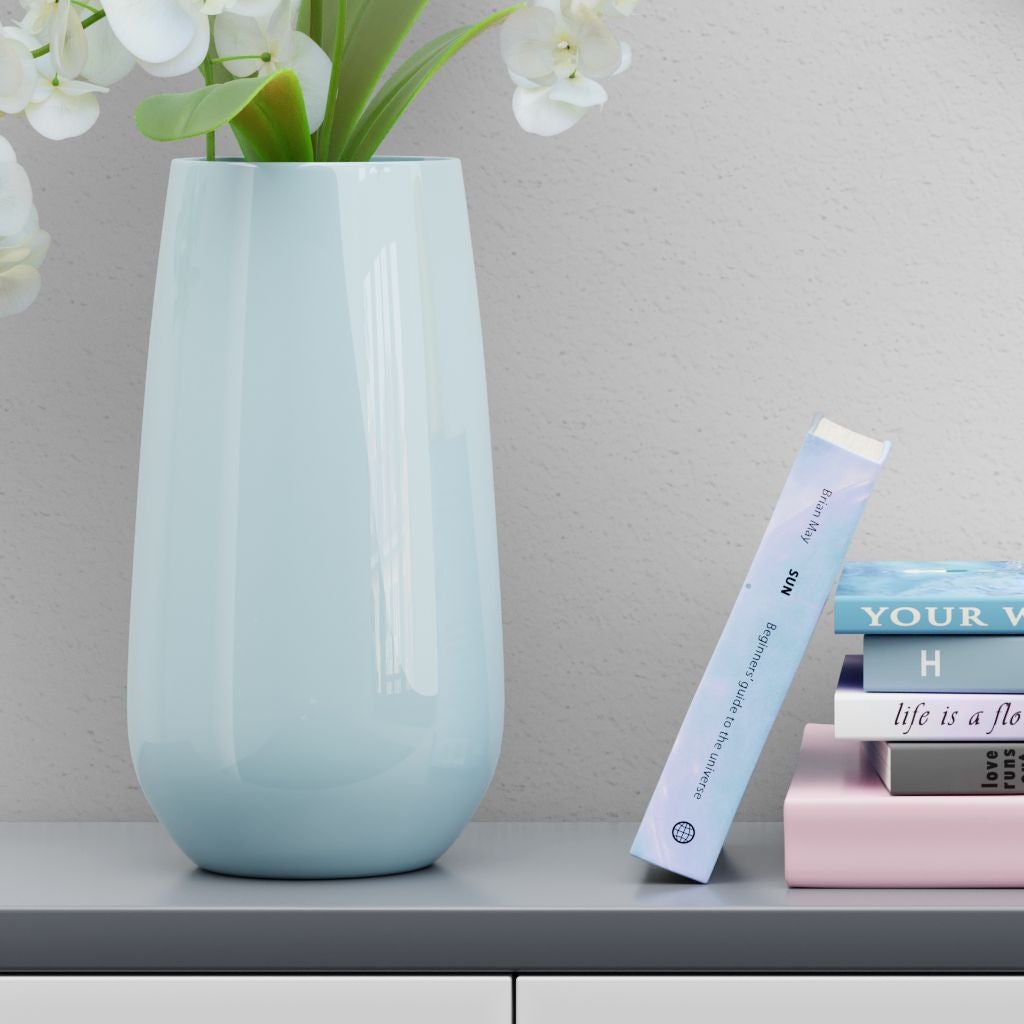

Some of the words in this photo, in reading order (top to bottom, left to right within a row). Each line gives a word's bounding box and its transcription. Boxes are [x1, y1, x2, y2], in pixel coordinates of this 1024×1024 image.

[816, 488, 833, 517] Brian
[800, 519, 820, 544] May
[781, 568, 799, 596] SUN
[861, 606, 988, 627] YOUR
[730, 680, 749, 714] guide
[723, 716, 735, 728] to
[894, 702, 930, 734] life
[940, 705, 959, 726] is
[968, 710, 984, 726] a
[714, 732, 729, 750] the
[694, 752, 719, 800] universe
[981, 750, 998, 788] love
[1004, 749, 1016, 789] runs
